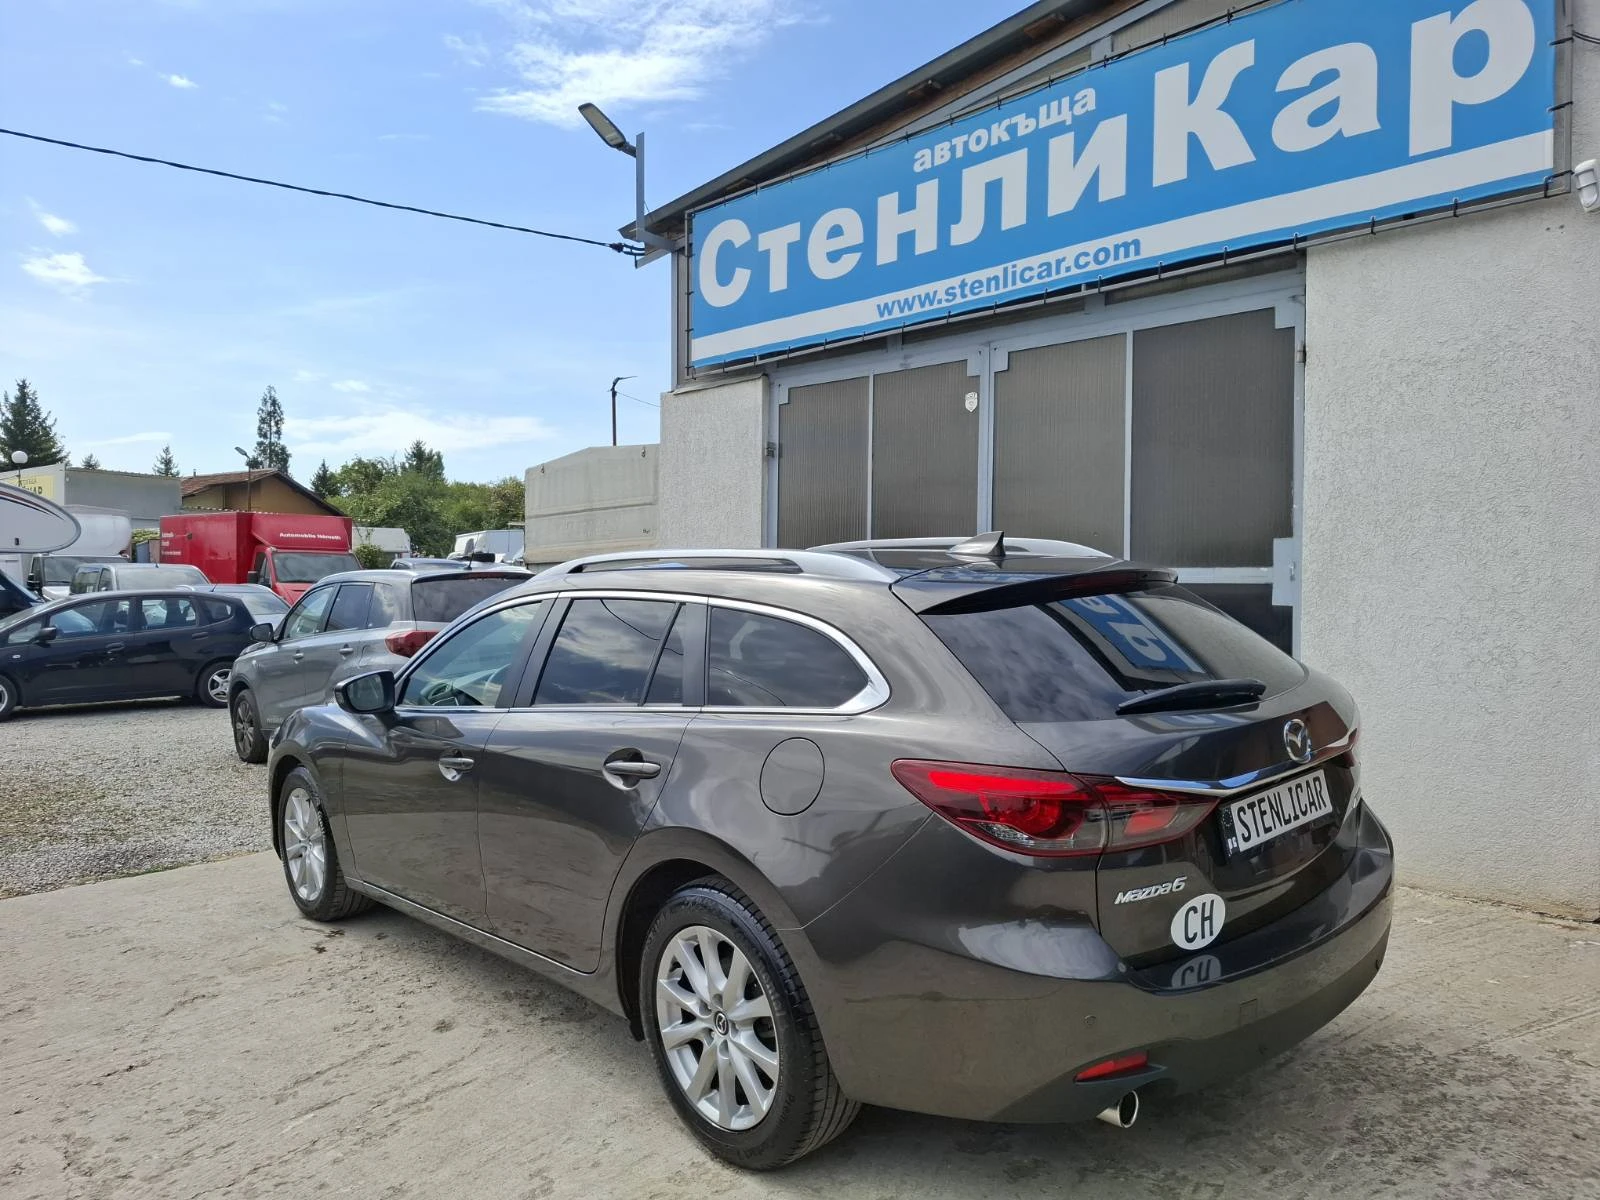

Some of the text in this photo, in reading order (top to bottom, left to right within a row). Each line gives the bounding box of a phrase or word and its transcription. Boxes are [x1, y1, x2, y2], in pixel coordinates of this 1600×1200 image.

[913, 87, 1096, 173] автокъща
[875, 235, 1141, 320] www.stenlicar.com
[1237, 776, 1327, 842] STENLICAR
[1114, 876, 1188, 905] Mazda6
[1184, 899, 1215, 944] CH
